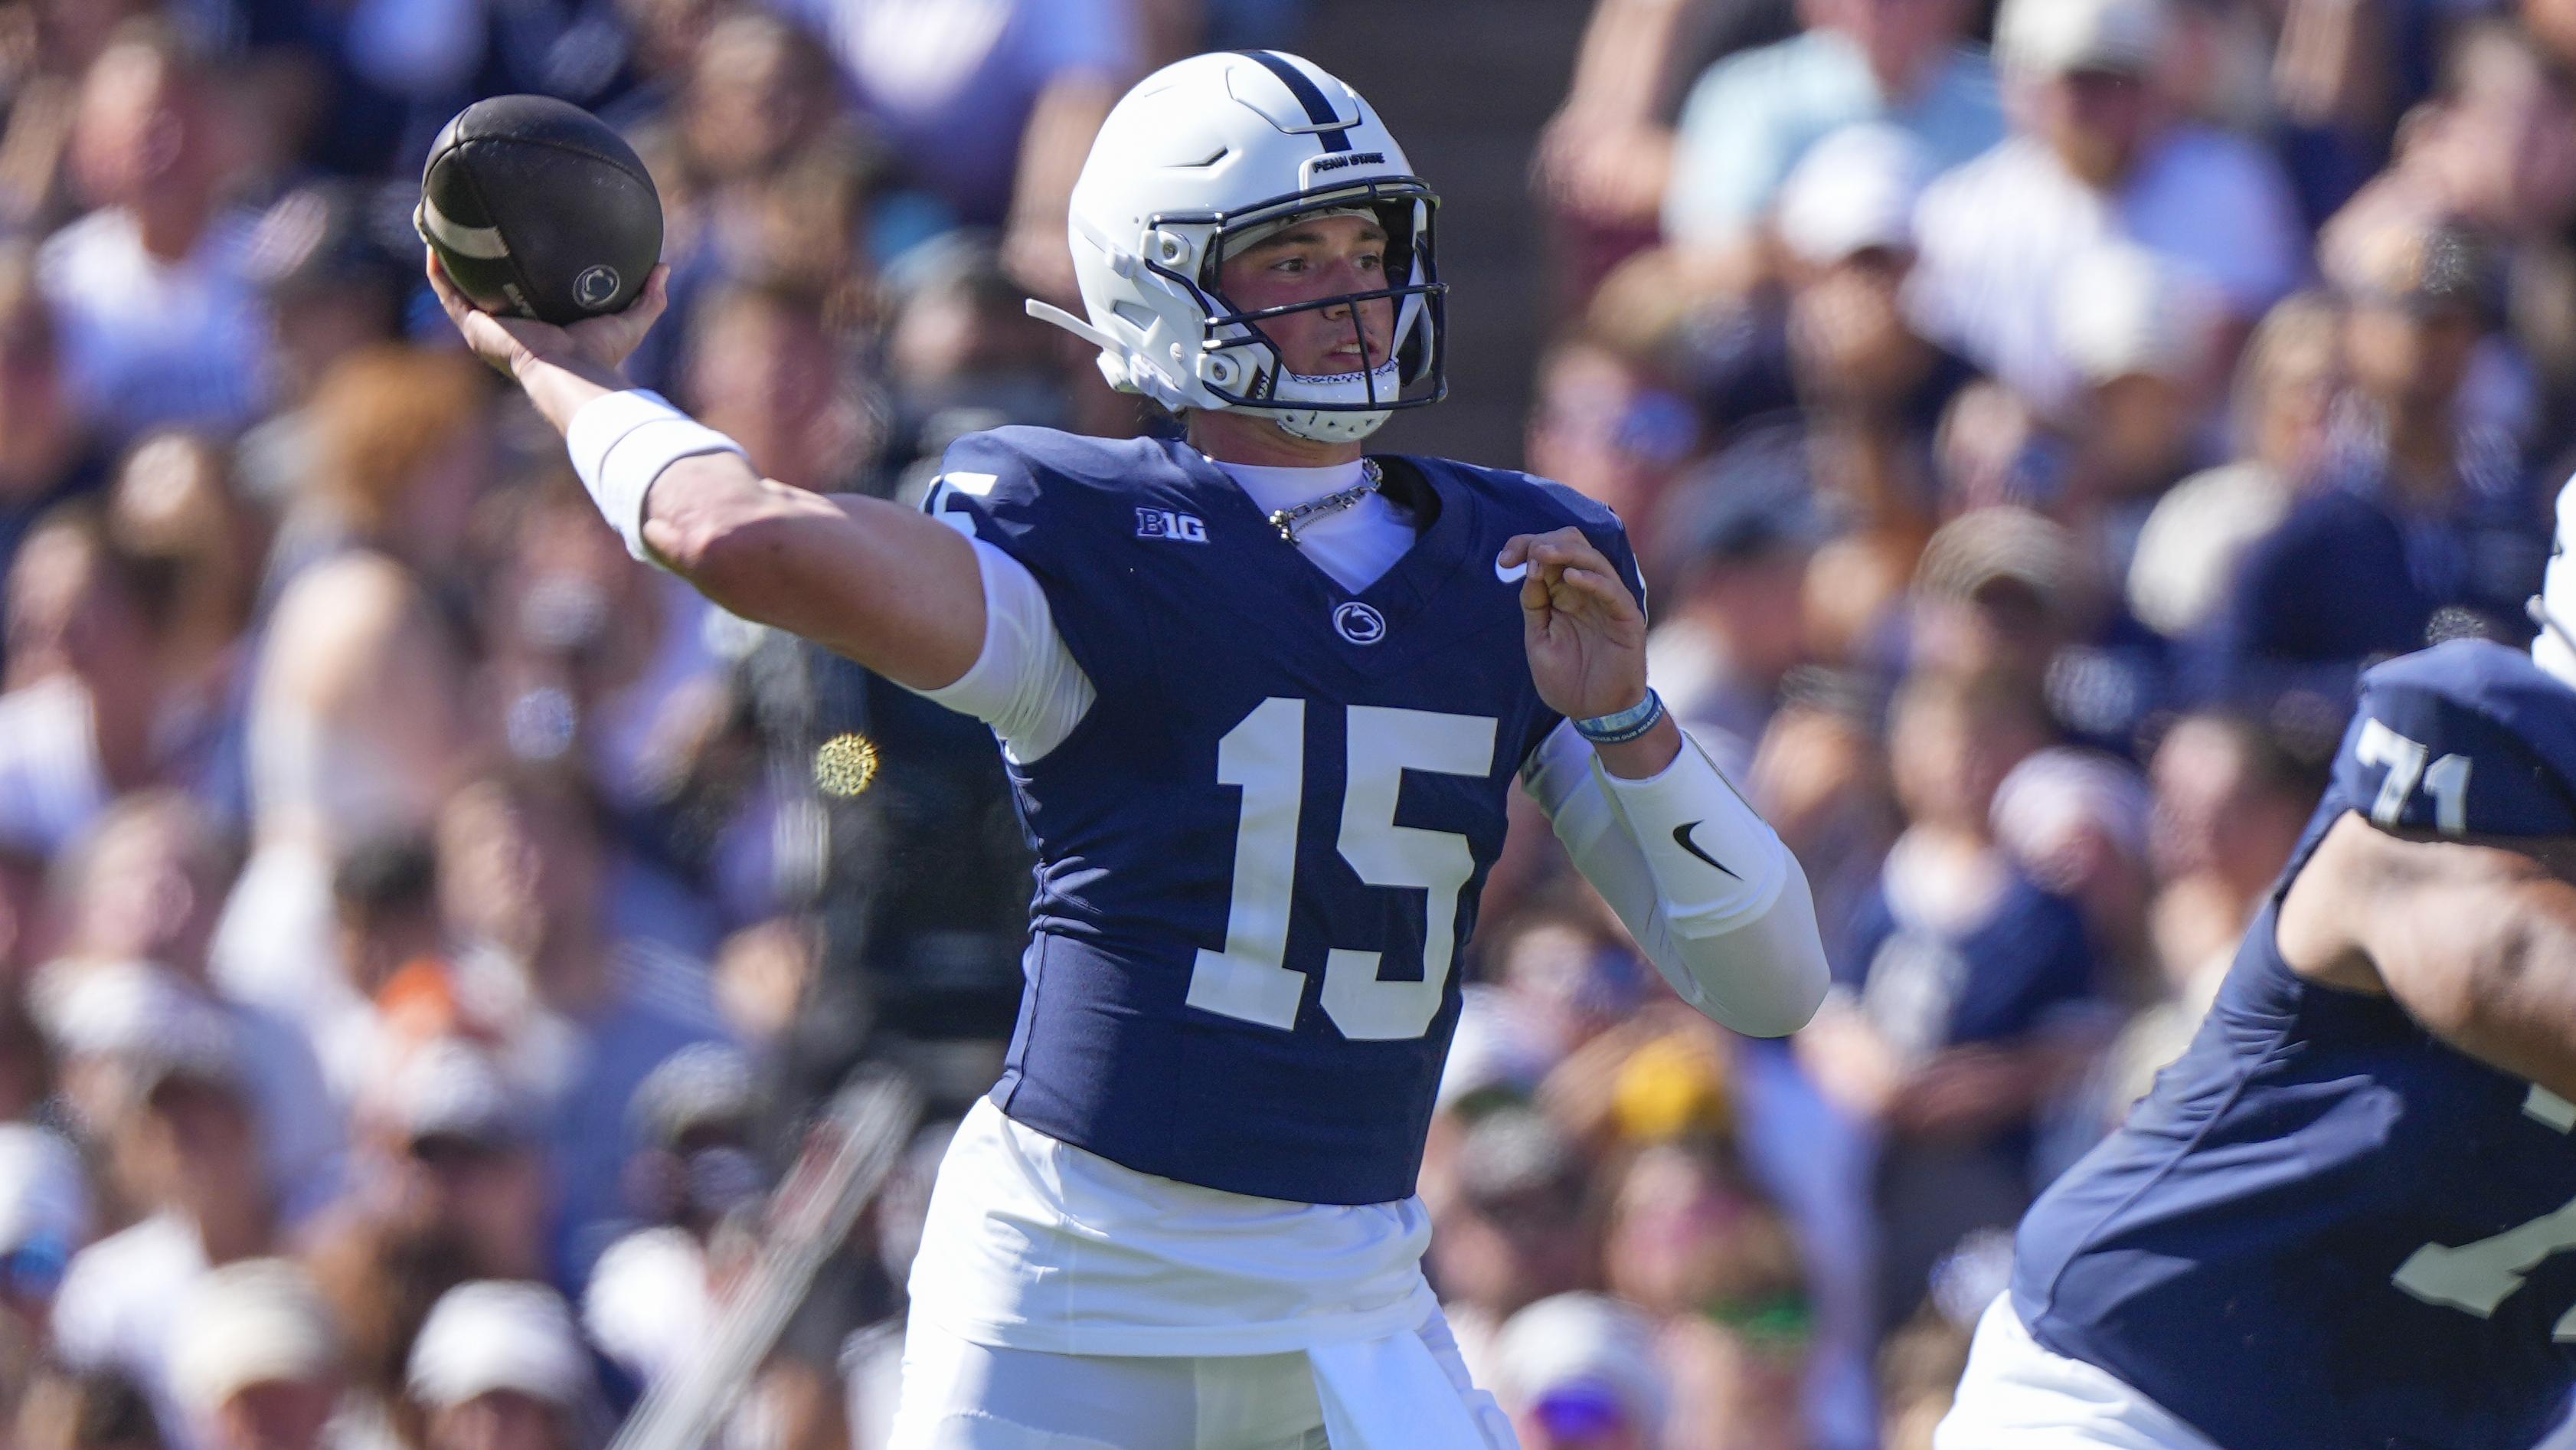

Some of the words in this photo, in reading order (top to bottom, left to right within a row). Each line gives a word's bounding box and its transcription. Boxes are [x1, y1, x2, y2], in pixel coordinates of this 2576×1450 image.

[1311, 155, 1349, 173] PENN
[1349, 152, 1385, 165] STATE
[1136, 506, 1210, 543] BIG
[2355, 716, 2473, 836] 71
[1185, 696, 1499, 1041] 15
